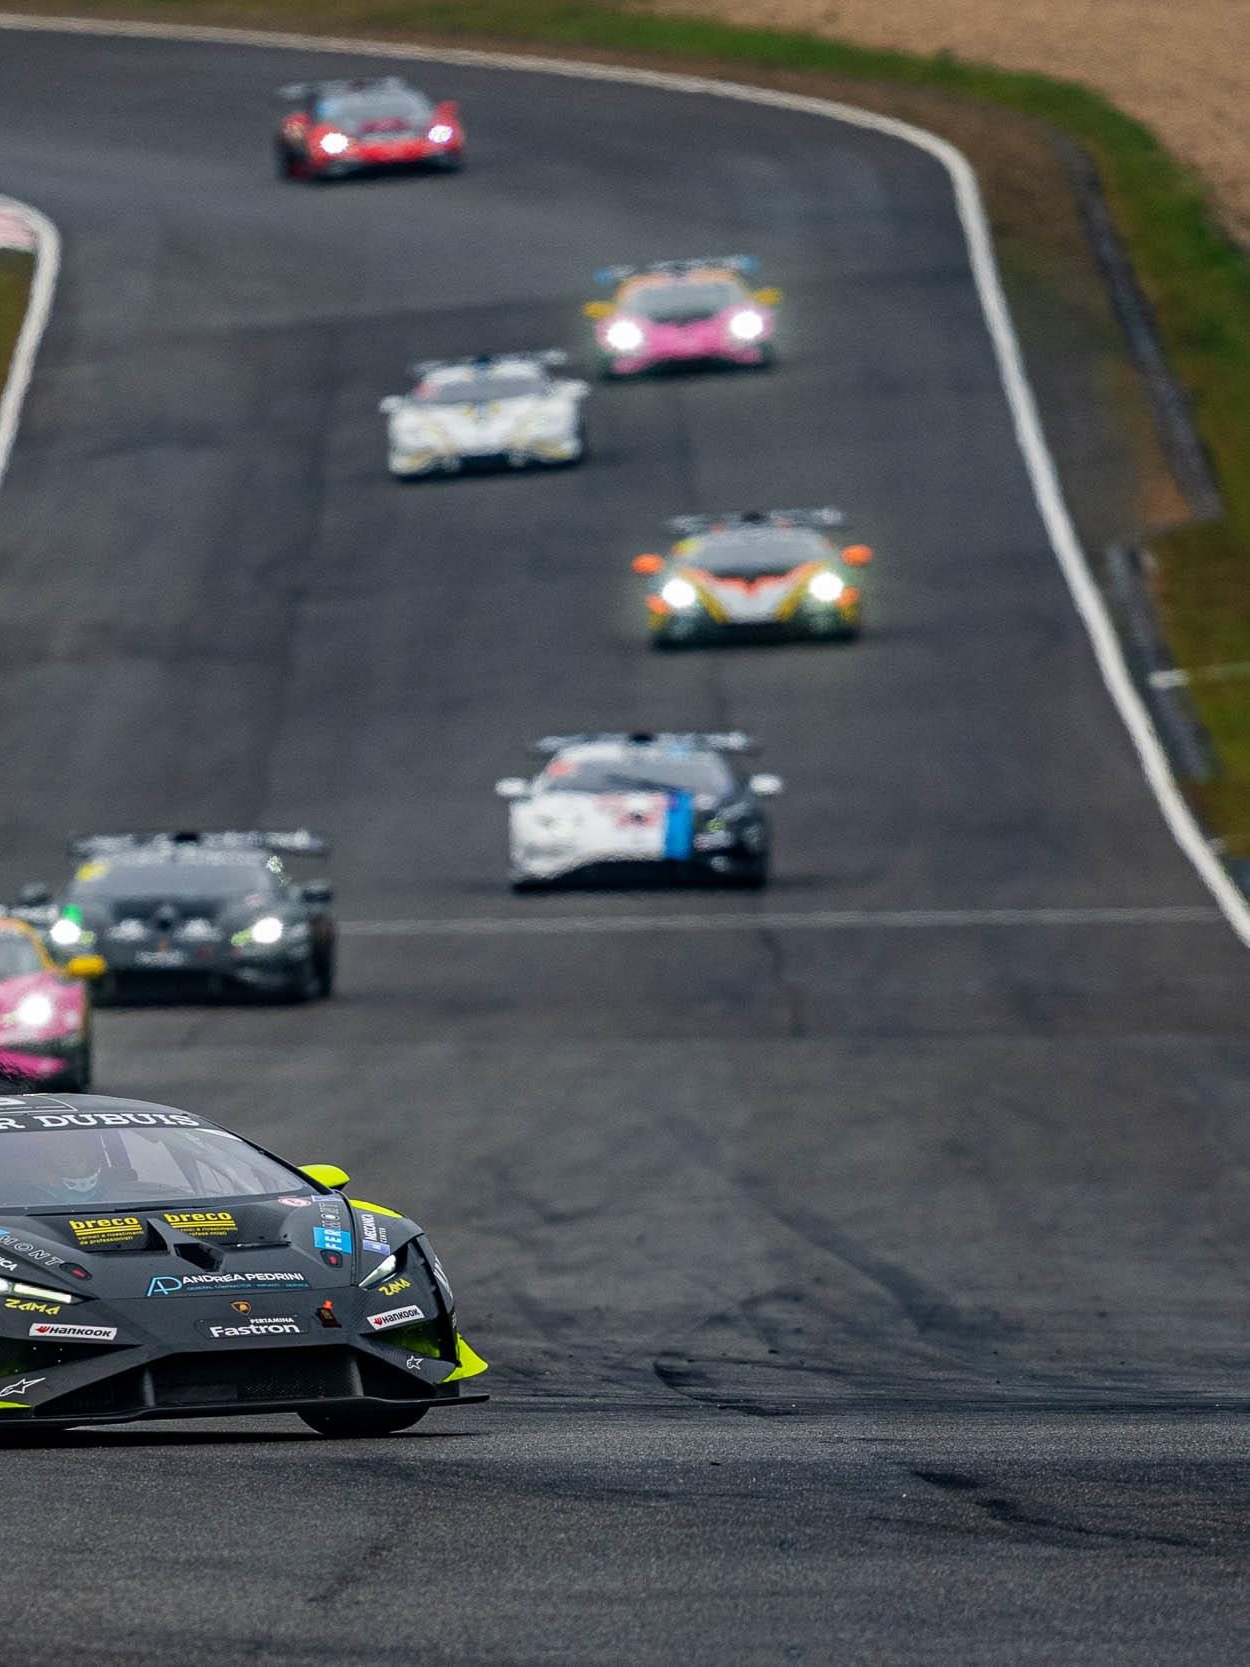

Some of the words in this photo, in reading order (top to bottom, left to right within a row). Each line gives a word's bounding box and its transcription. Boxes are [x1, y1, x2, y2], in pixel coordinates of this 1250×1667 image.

[33, 1112, 200, 1128] DUBUIS
[69, 1217, 138, 1230] breco
[163, 1212, 232, 1223] breco
[183, 1273, 244, 1285] ANDREA
[244, 1272, 304, 1281] PEDRINI
[4, 1298, 62, 1315] ZAMA
[209, 1324, 301, 1338] Fastron
